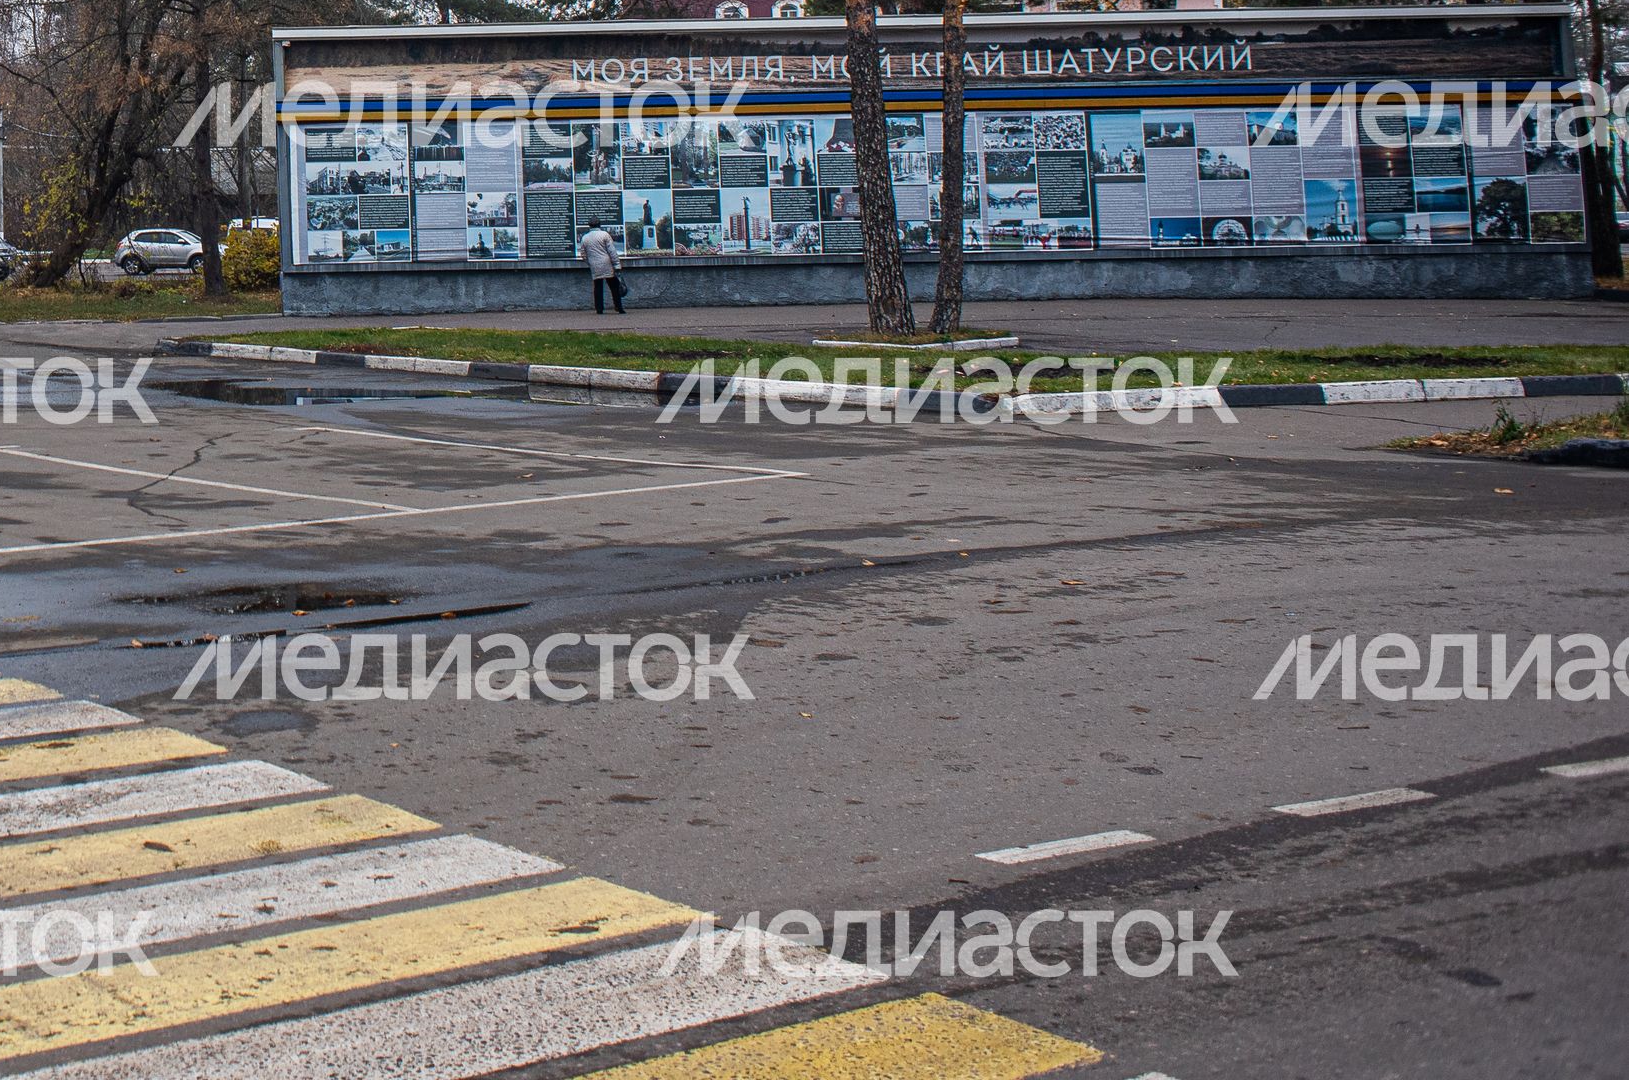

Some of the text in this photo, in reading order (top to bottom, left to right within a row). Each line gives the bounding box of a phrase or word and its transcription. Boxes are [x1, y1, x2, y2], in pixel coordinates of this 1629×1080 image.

[572, 58, 649, 83] МОЯ
[666, 55, 795, 83] ЗЕМЛЯ,
[1023, 39, 1253, 75] ШАТУРСКИЙ
